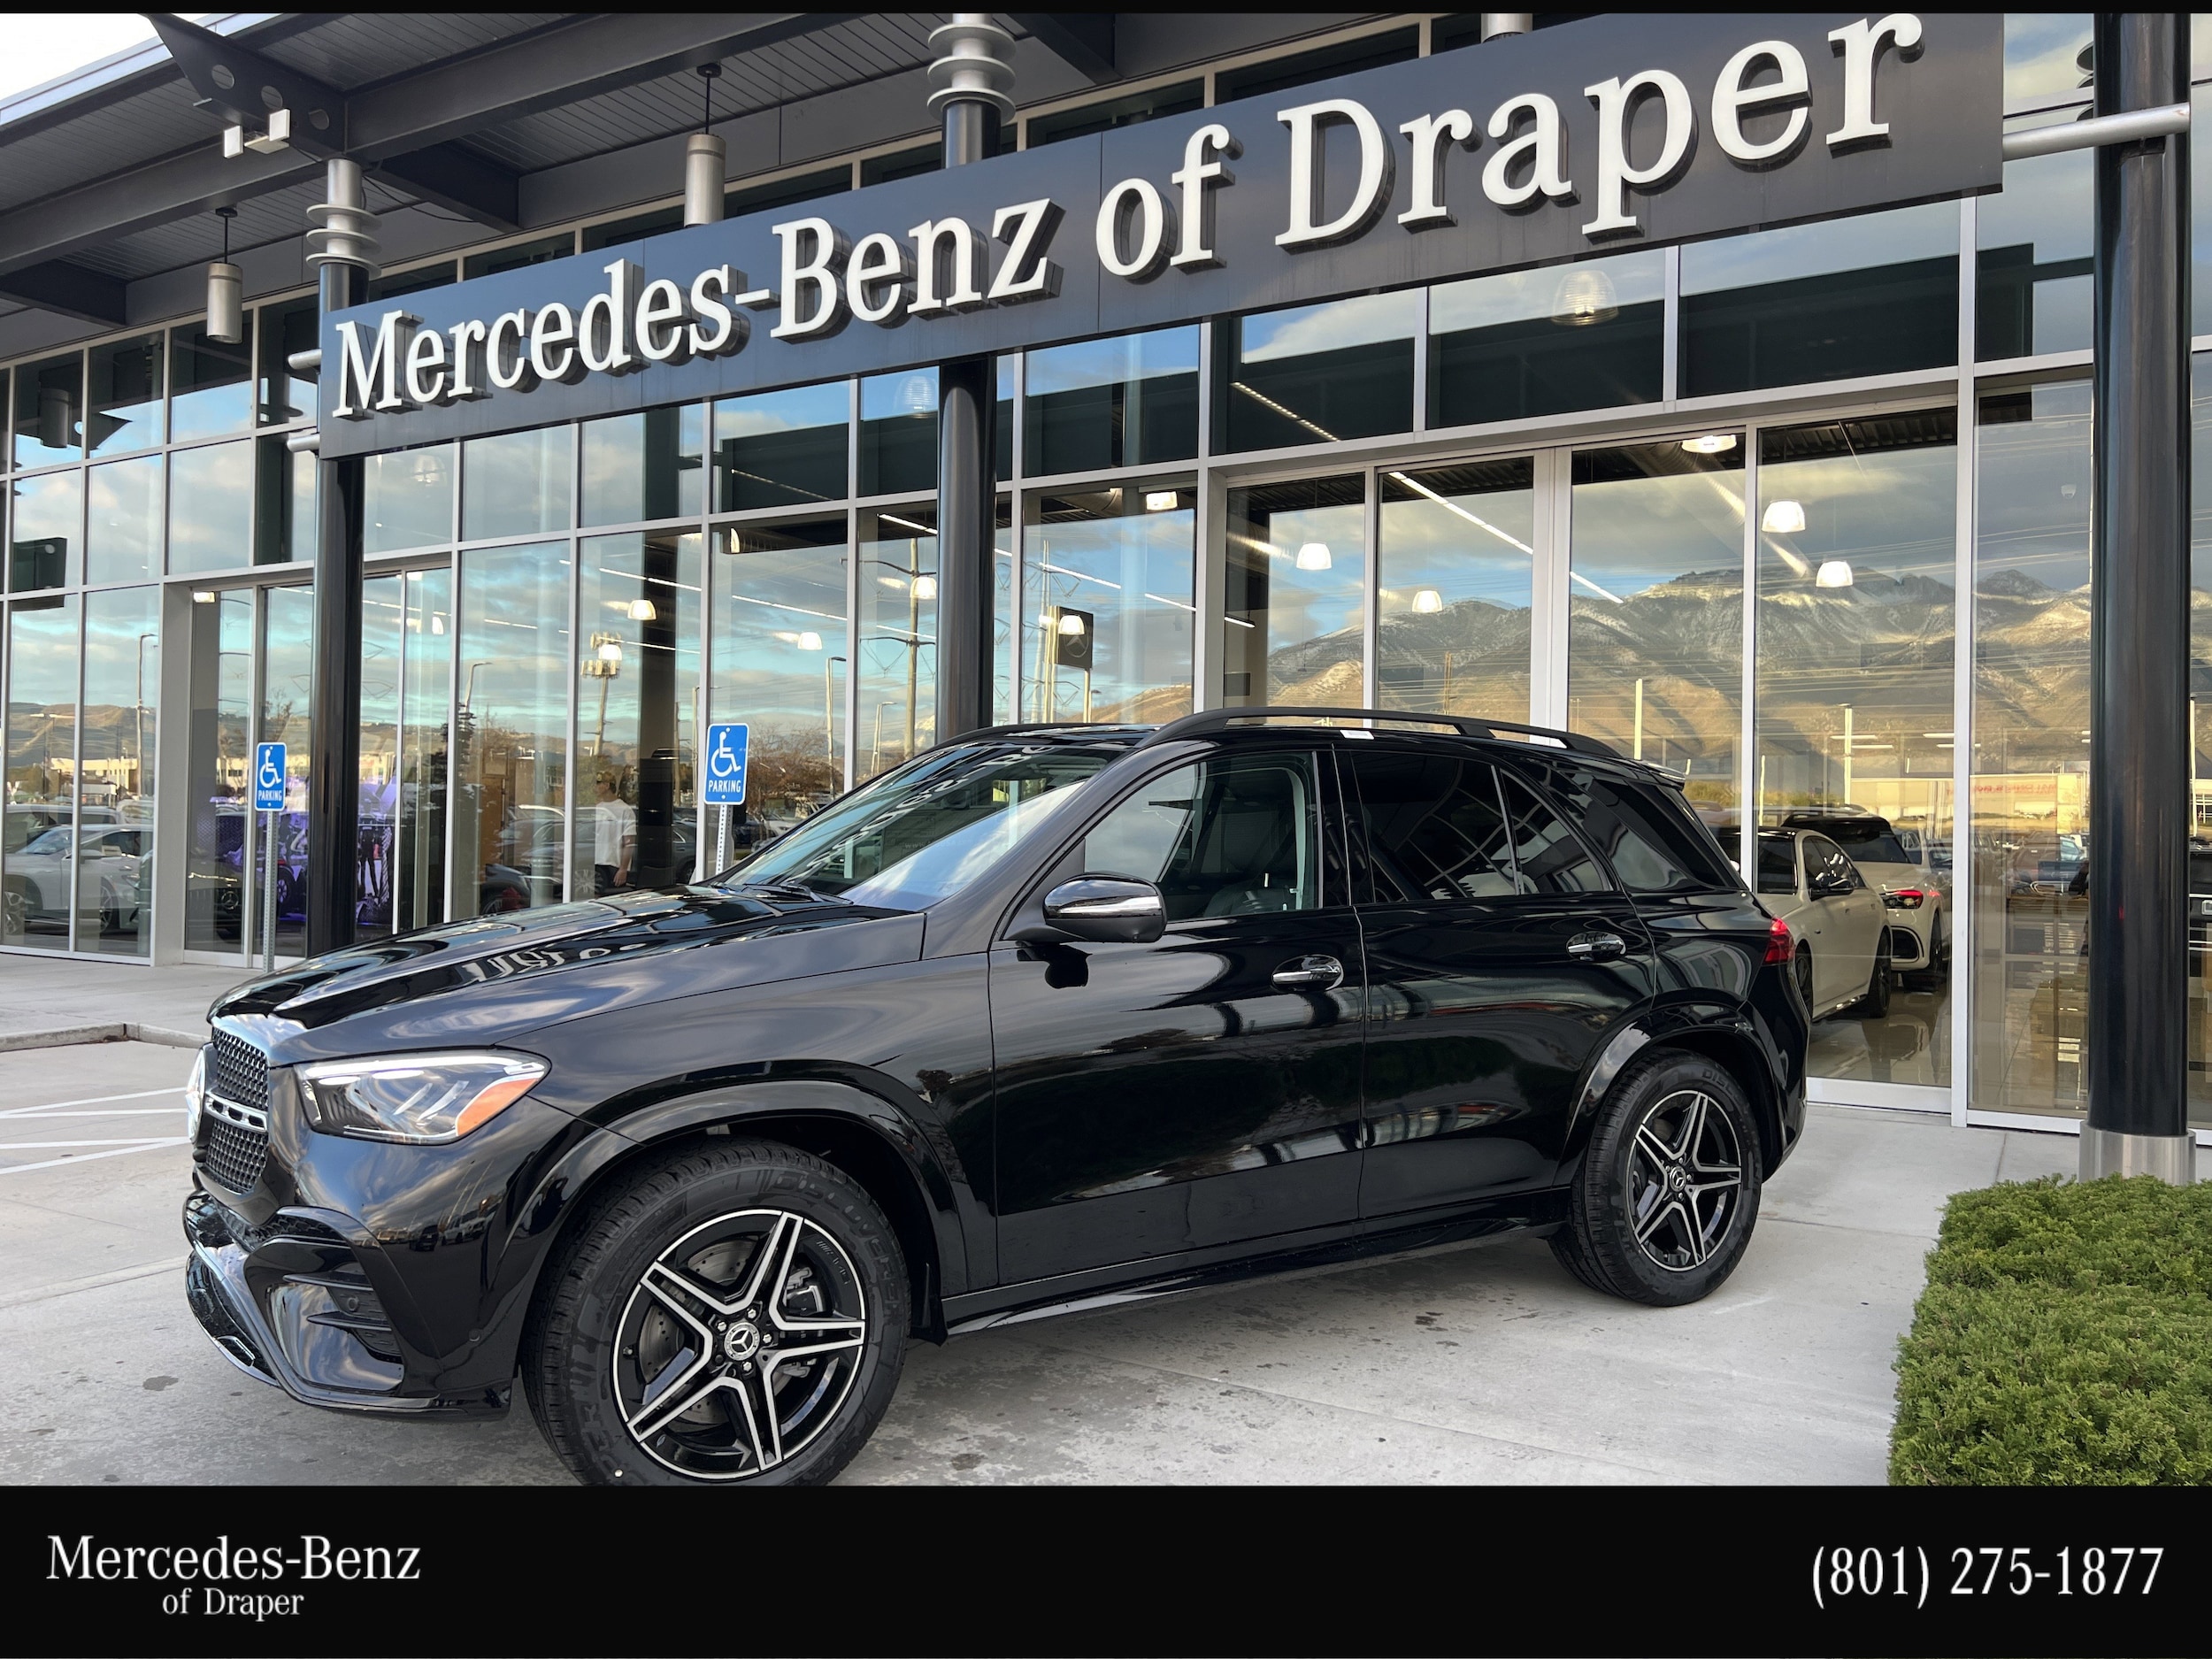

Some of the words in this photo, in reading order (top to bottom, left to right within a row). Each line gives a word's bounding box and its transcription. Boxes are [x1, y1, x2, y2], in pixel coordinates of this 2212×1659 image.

[331, 197, 1056, 419] Mercedes-Benz
[1095, 123, 1236, 277] of
[1274, 13, 1924, 248] Draper
[708, 780, 741, 793] PARKING
[257, 789, 282, 802] PARKING
